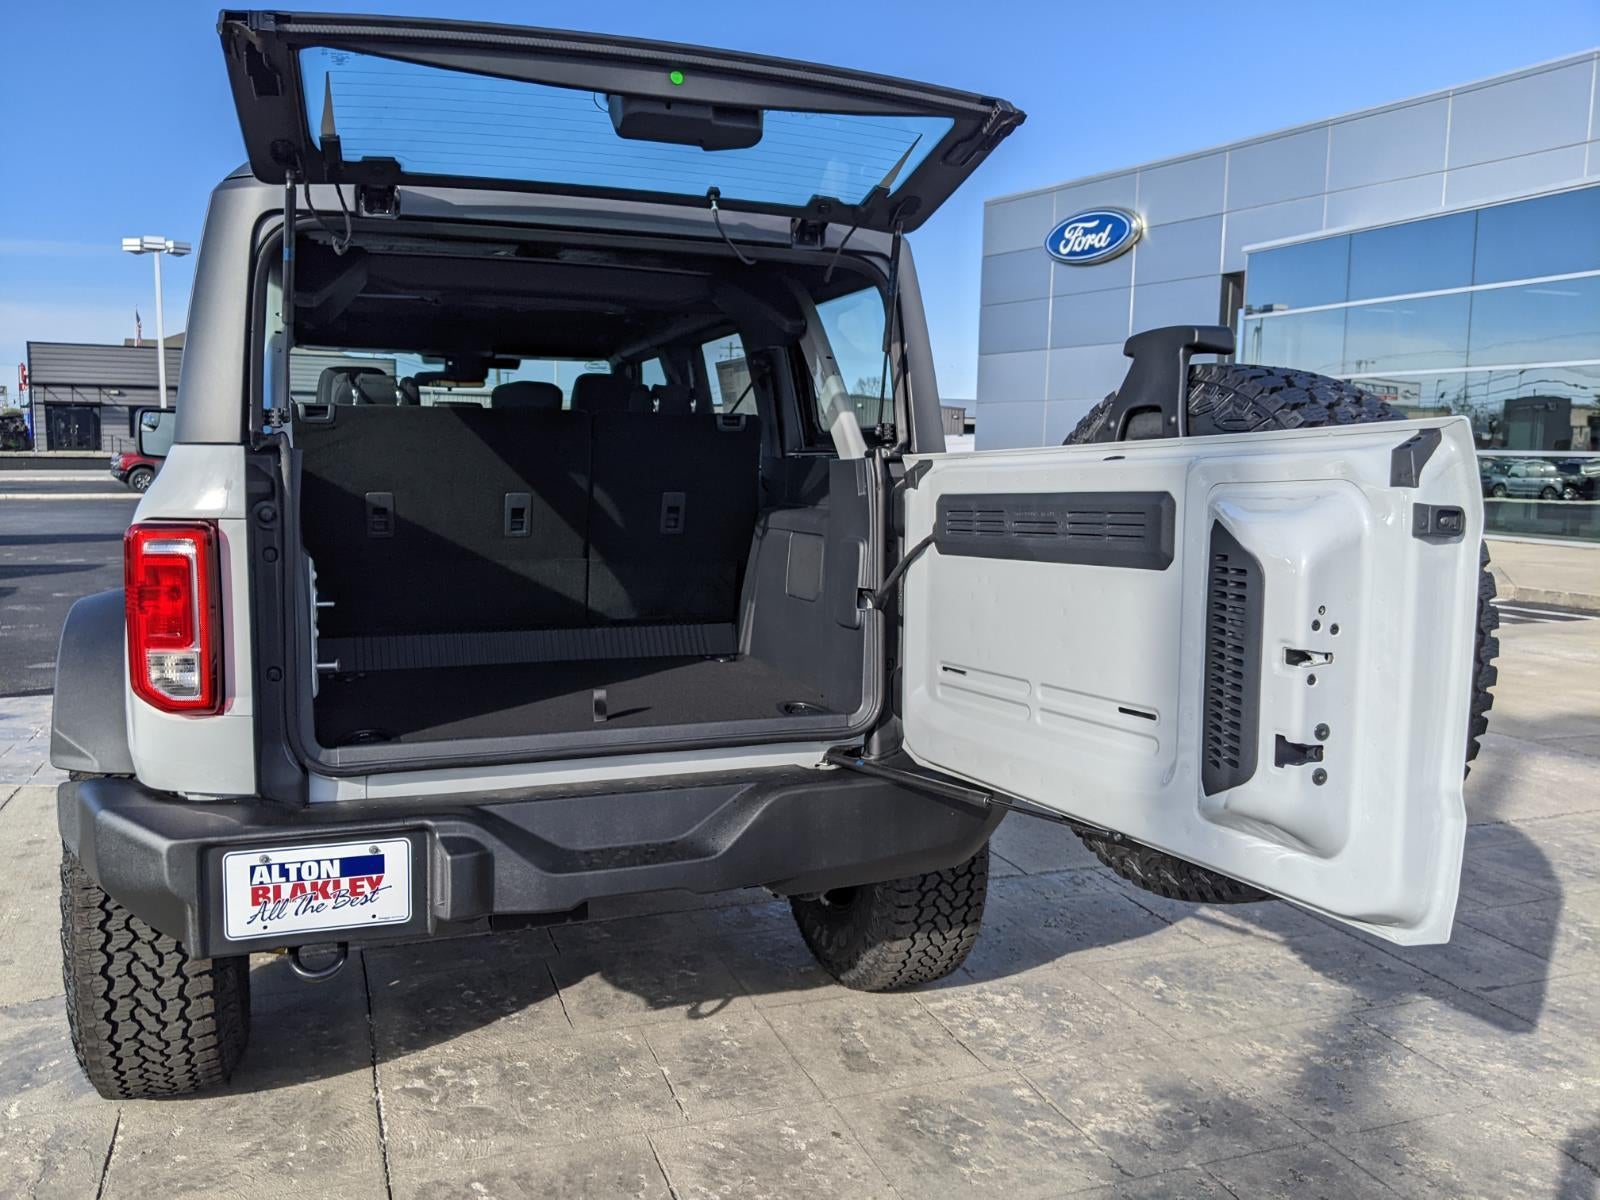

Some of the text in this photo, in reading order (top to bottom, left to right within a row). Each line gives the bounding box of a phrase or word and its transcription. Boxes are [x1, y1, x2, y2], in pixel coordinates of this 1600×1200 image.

[1059, 219, 1113, 255] Ford
[252, 860, 341, 885] ALTON
[247, 885, 392, 924] All The Best
[251, 875, 384, 906] BLAKLEY
